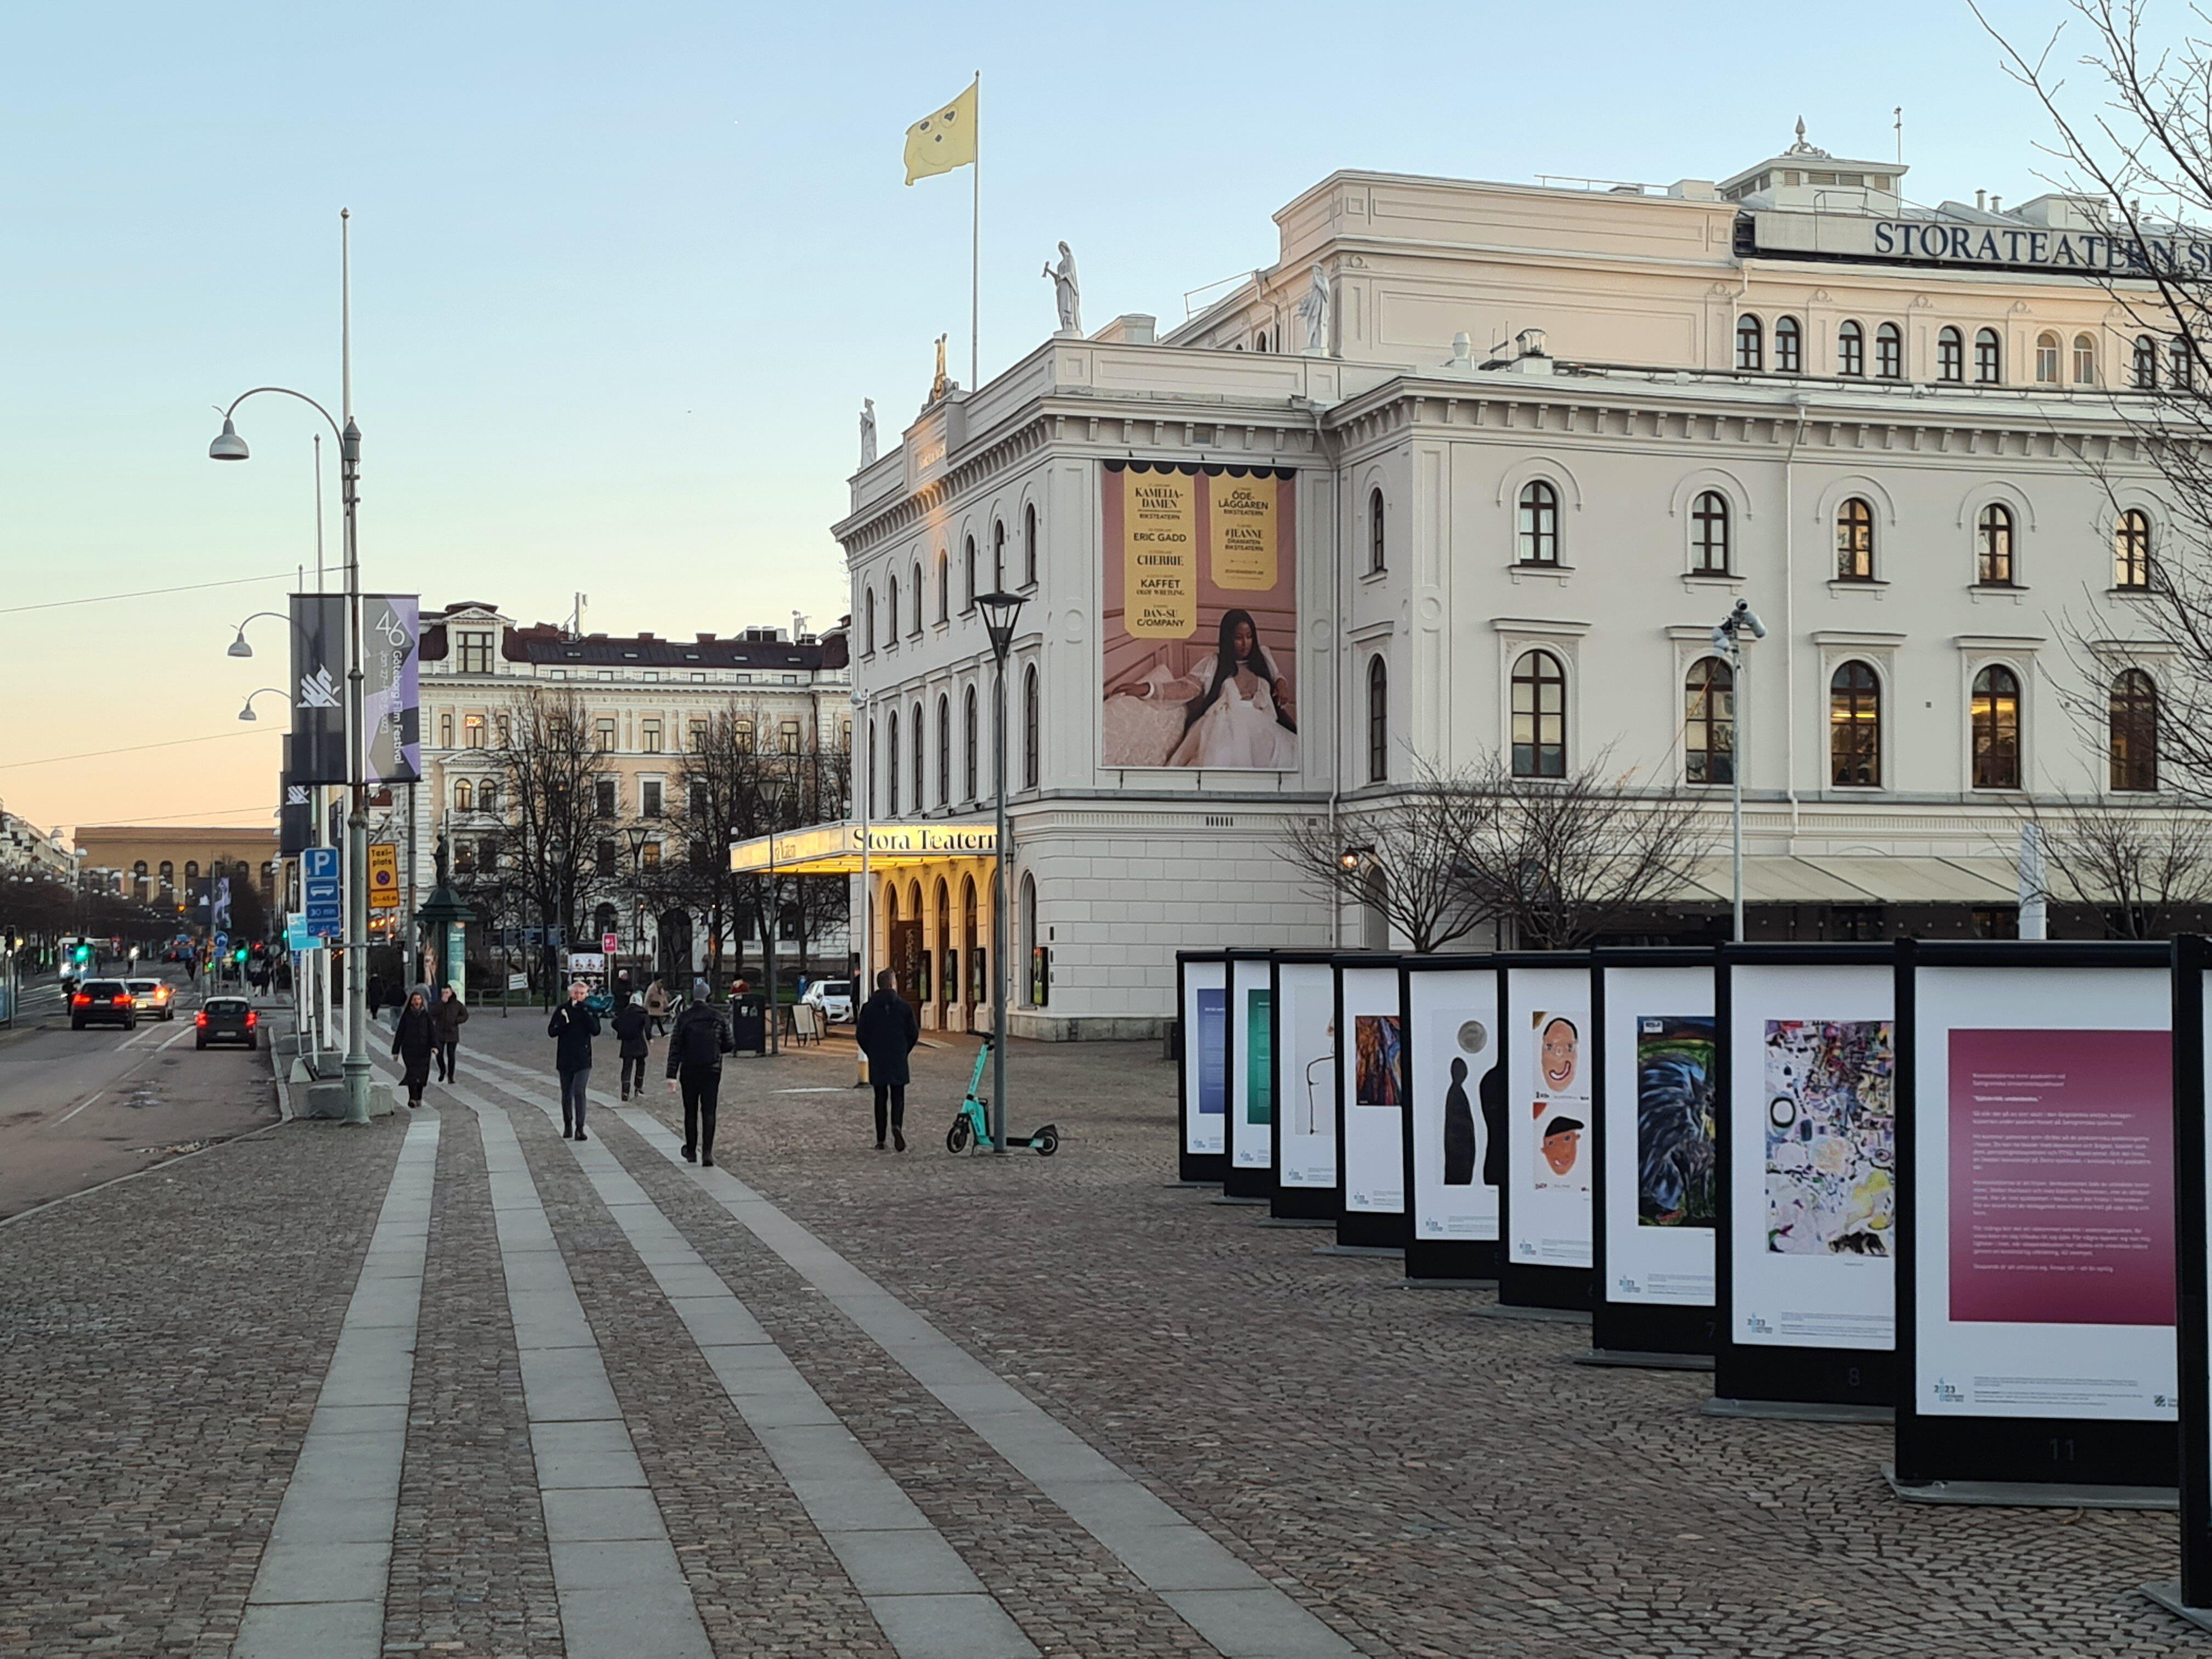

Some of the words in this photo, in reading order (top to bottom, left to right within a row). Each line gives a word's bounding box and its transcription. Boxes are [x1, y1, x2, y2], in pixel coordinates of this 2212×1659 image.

[1133, 532, 1155, 541] ERIC
[1158, 533, 1187, 543] GADD
[1137, 555, 1184, 566] CHERRIE
[1141, 579, 1181, 589] KAFFET
[374, 610, 405, 647] 46
[391, 650, 403, 699] Göteborg
[393, 701, 403, 723] Film
[393, 725, 405, 765] Festival
[853, 828, 910, 850] Stora
[314, 851, 330, 876] P
